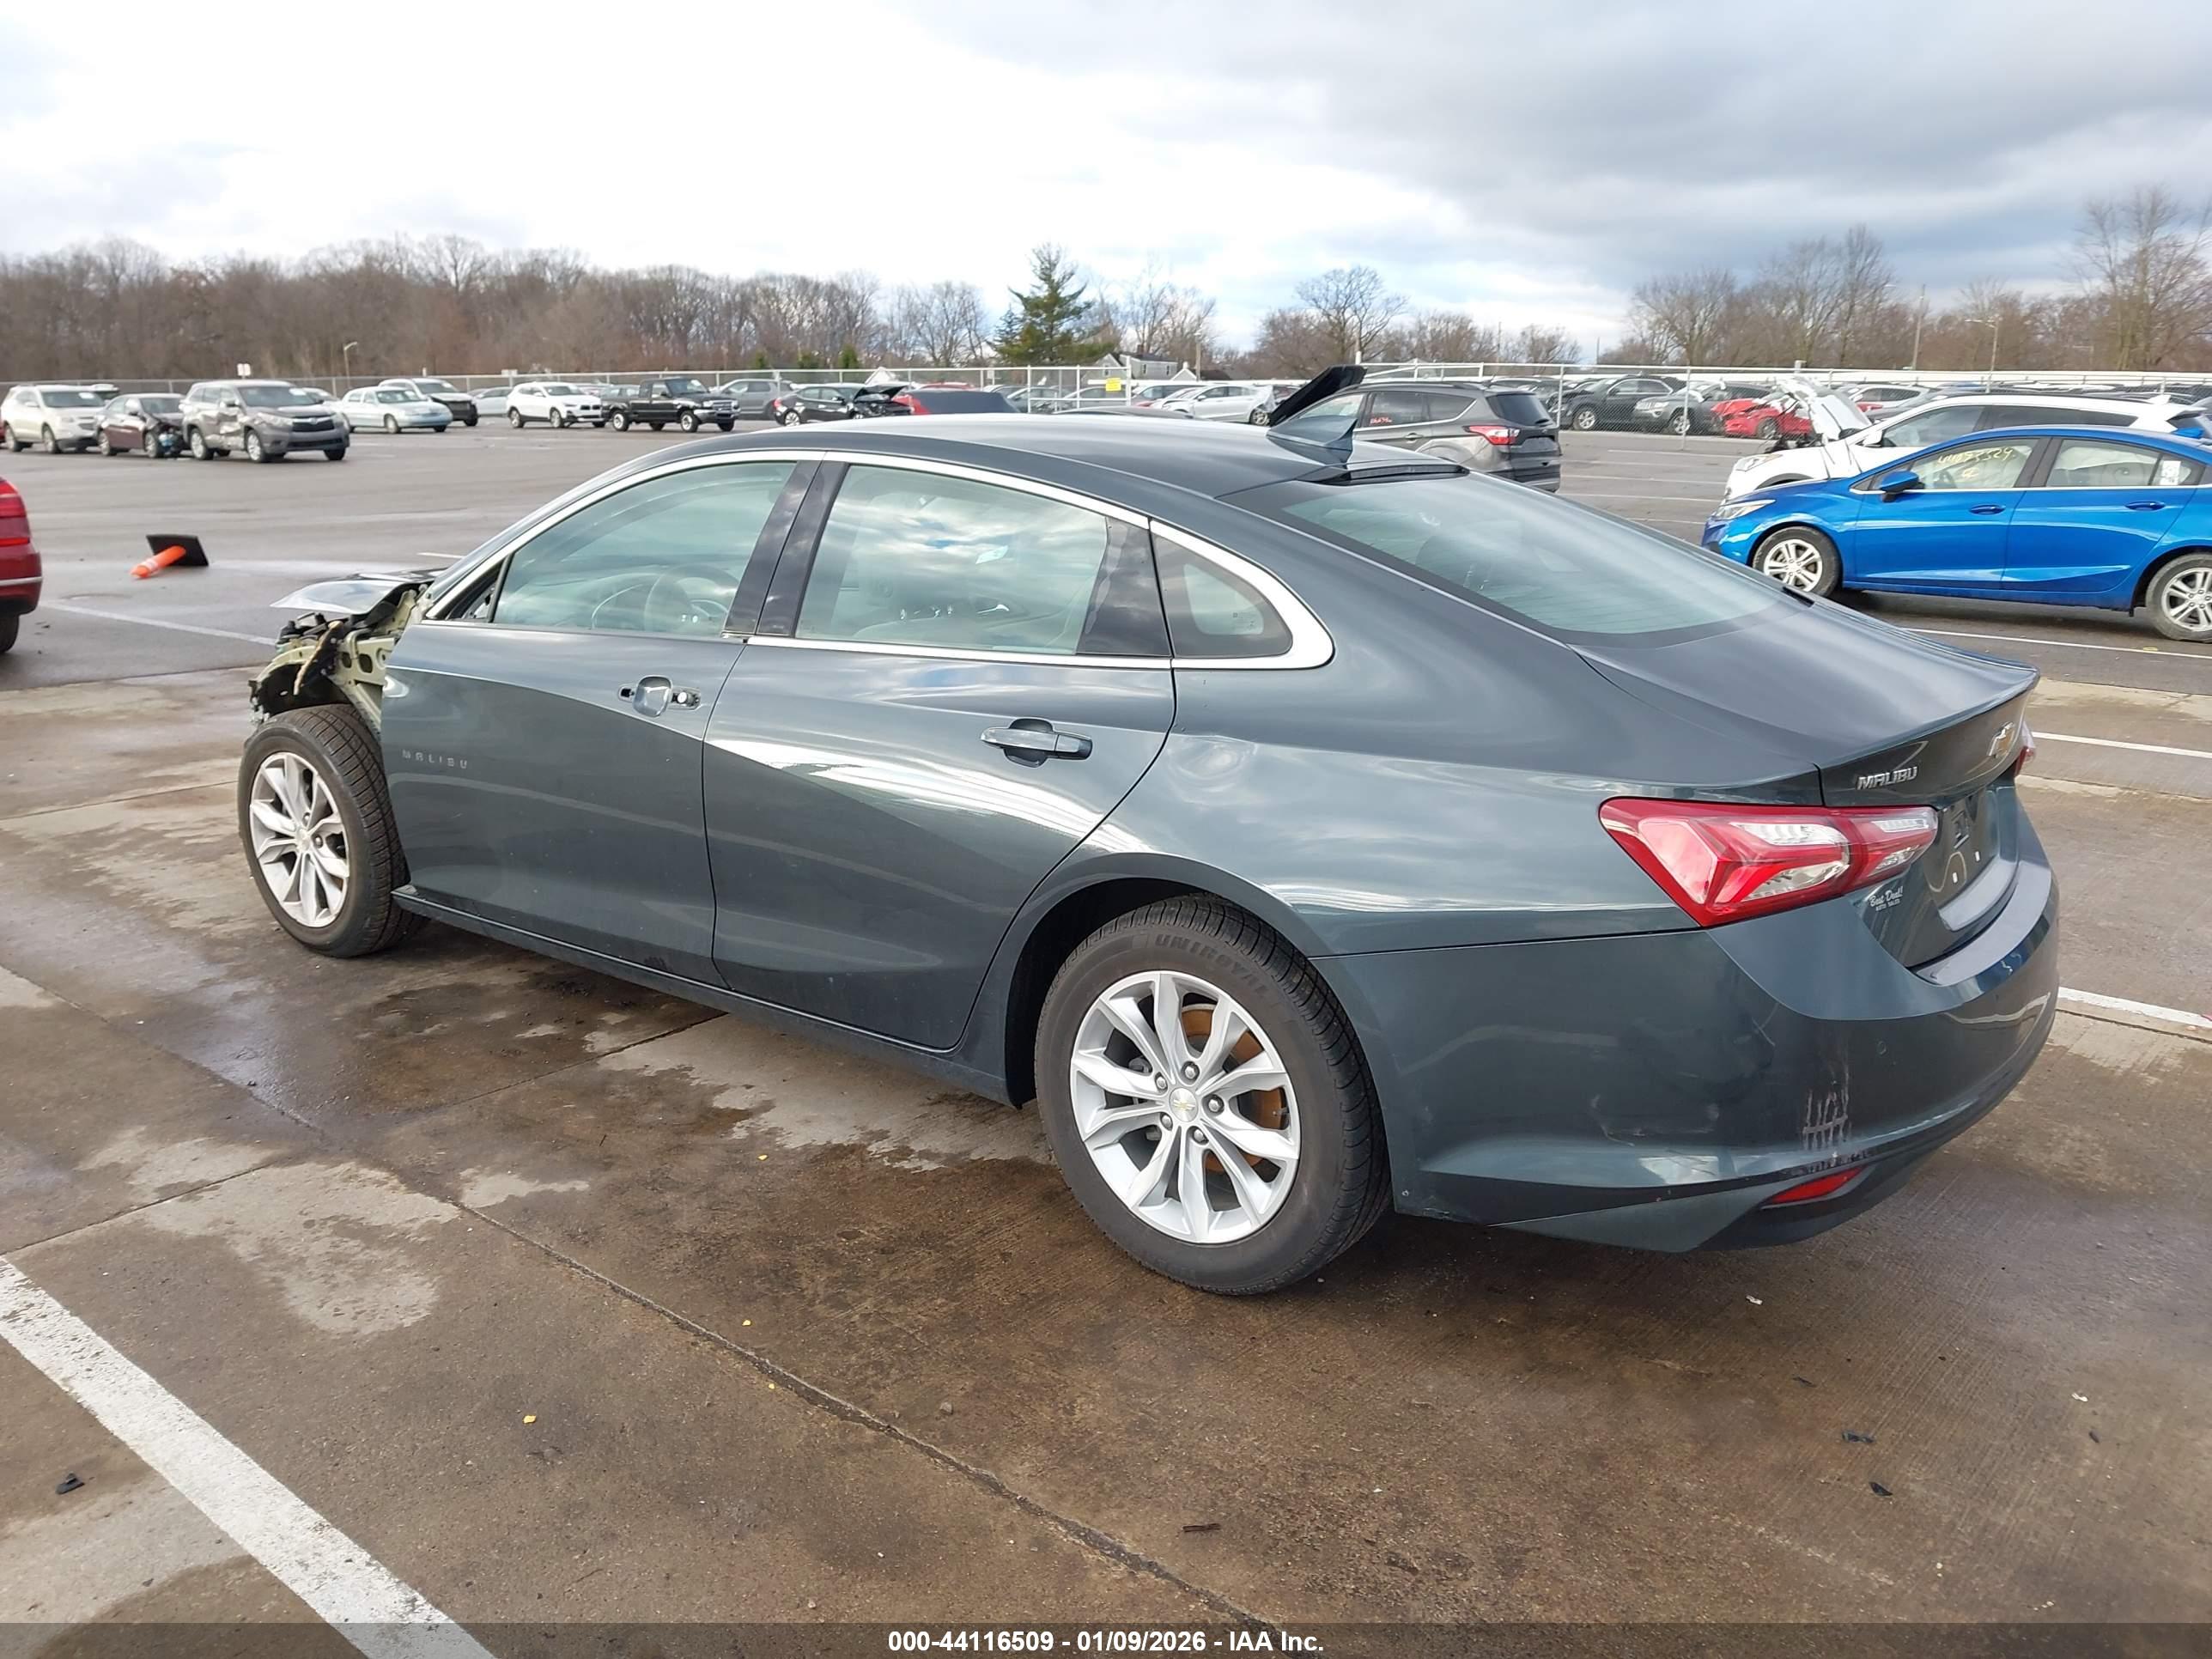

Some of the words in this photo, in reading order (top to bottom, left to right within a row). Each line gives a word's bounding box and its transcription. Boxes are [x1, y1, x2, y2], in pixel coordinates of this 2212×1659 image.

[402, 749, 468, 769] MALIBU
[1857, 766, 1917, 790] MALIBU
[1154, 933, 1271, 998] UNIROYAL
